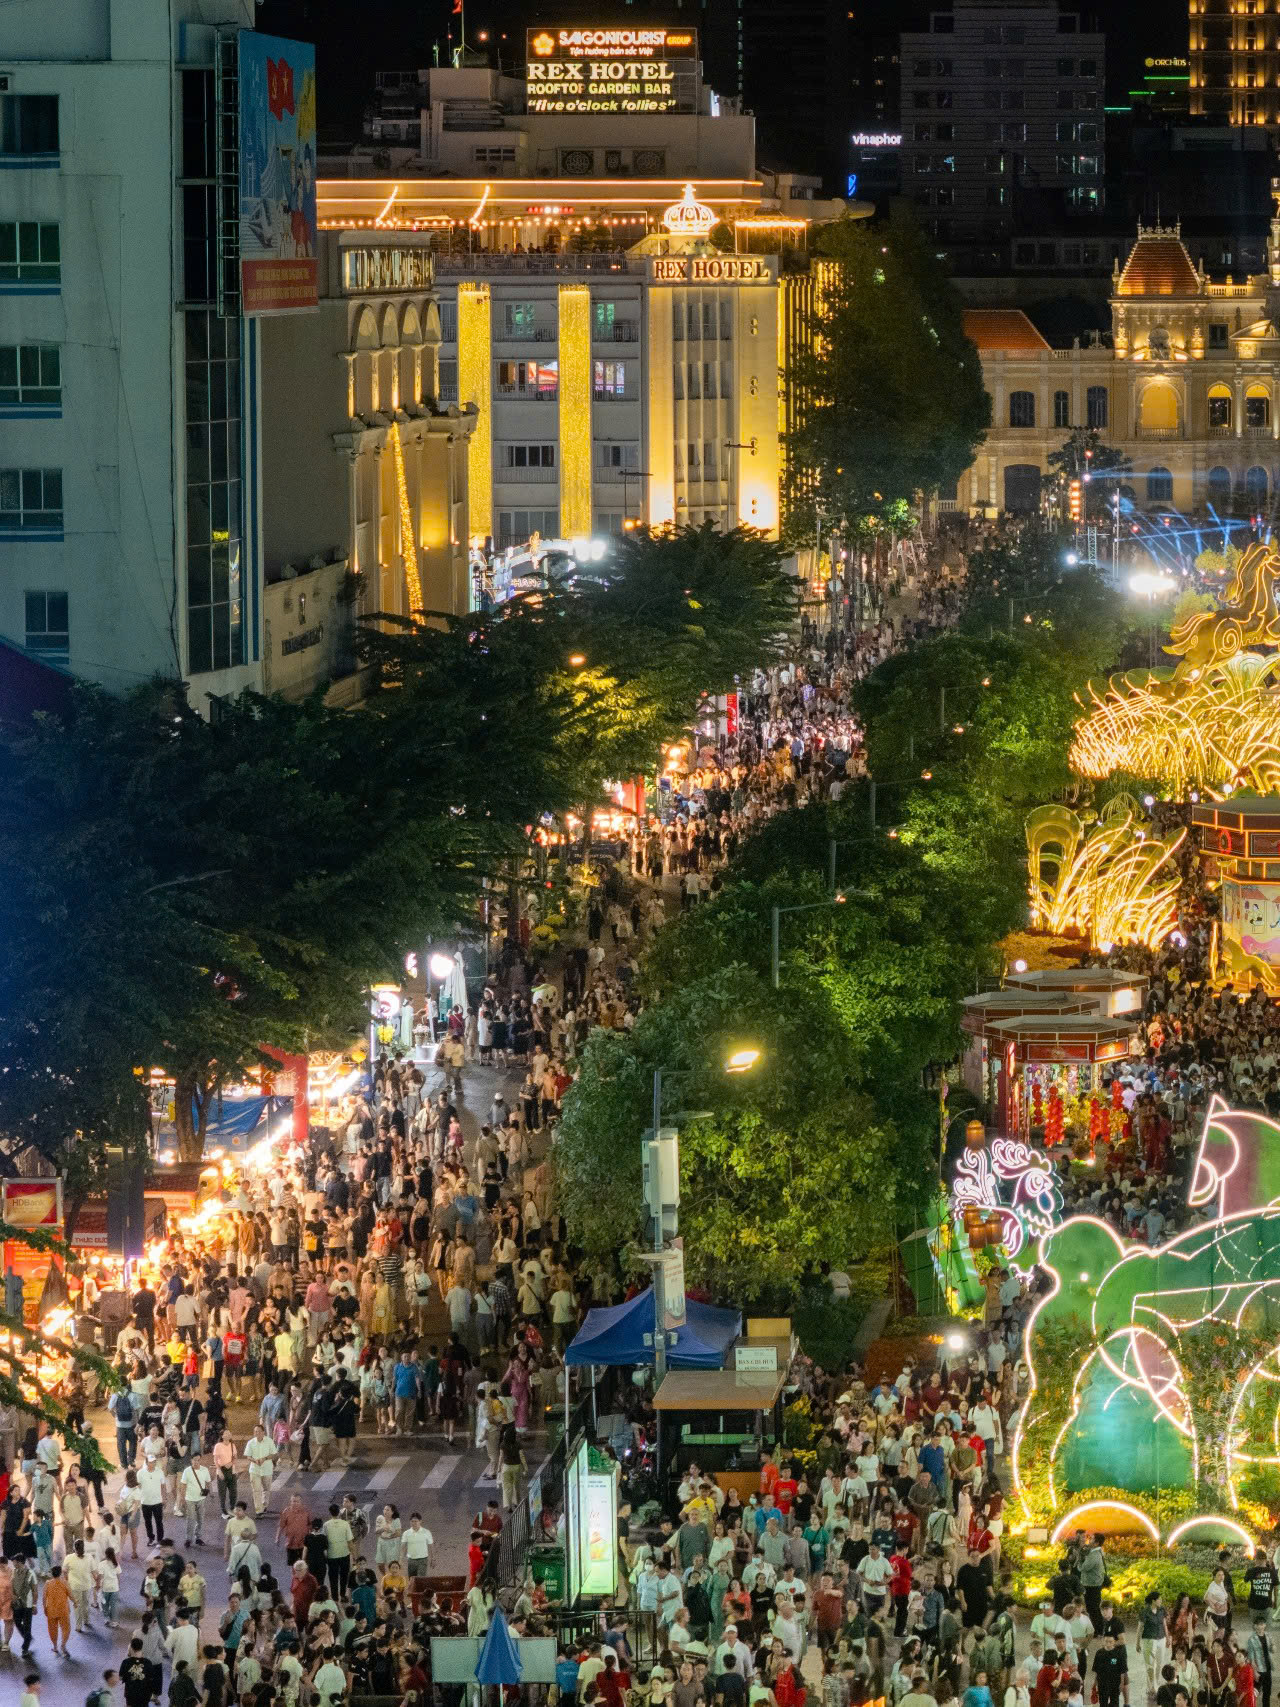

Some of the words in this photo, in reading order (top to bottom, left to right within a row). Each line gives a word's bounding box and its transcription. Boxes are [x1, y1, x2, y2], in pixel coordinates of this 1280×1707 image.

[559, 31, 667, 45] SAIGONTOURIST
[666, 35, 692, 45] GROUP
[527, 62, 584, 80] REX
[589, 62, 675, 80] HOTEL
[527, 83, 585, 95] ROOFTOP
[588, 83, 641, 95] GARDEN
[645, 83, 671, 95] BAR
[654, 260, 688, 280] REX
[693, 260, 769, 279] HOTEL
